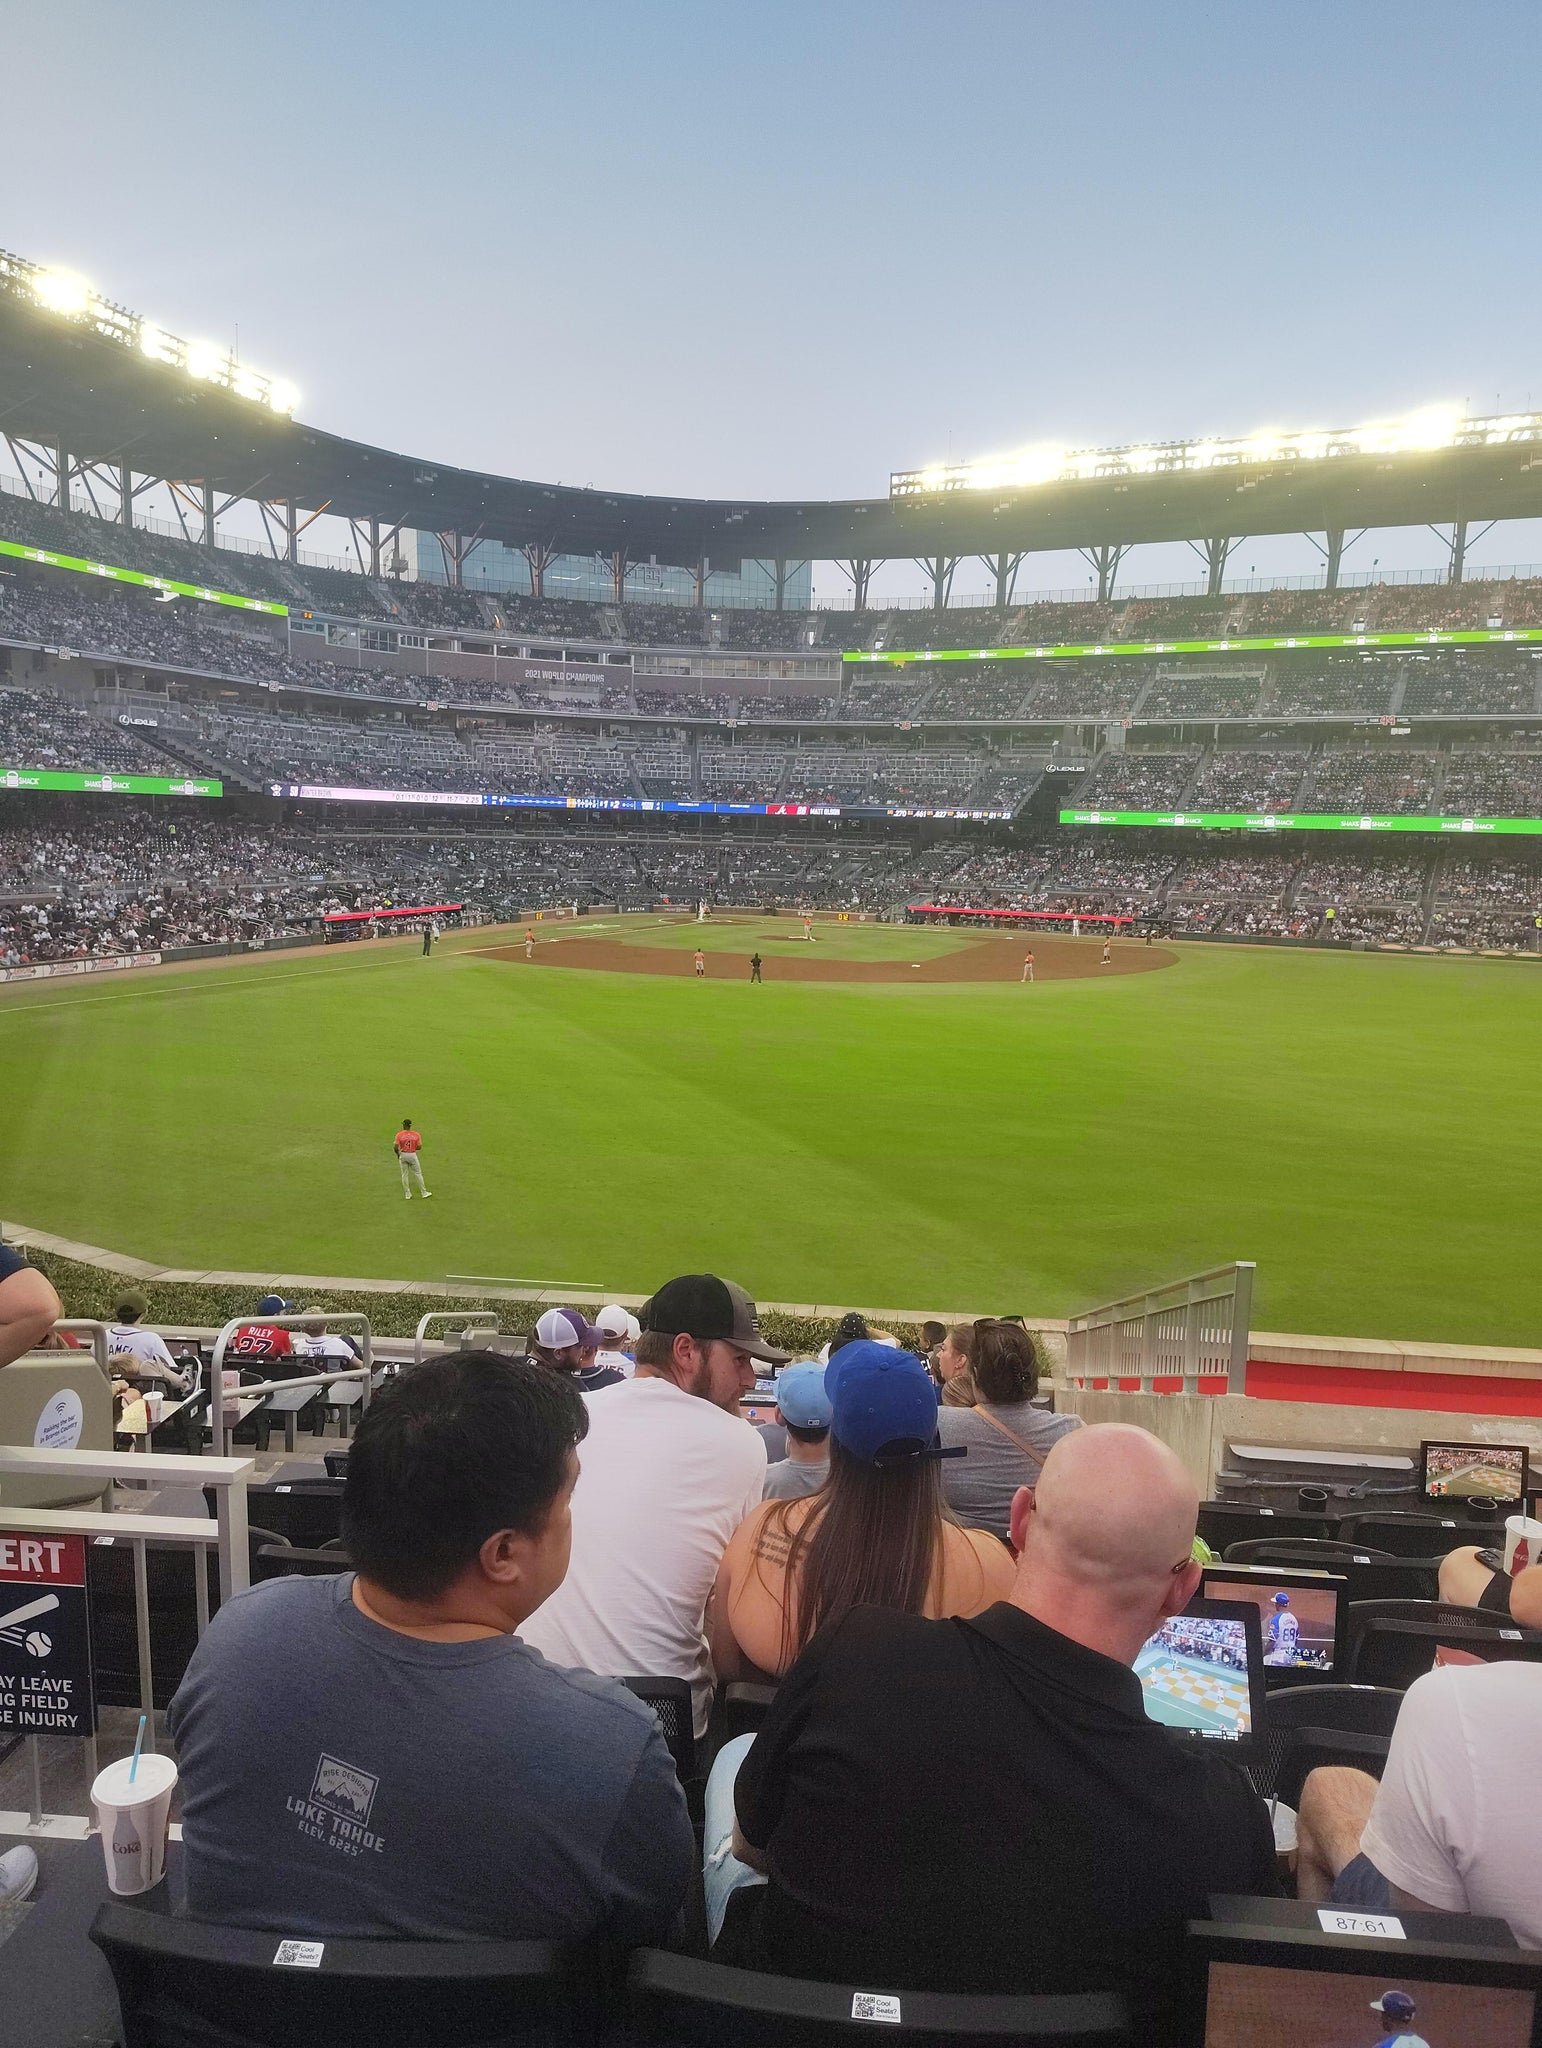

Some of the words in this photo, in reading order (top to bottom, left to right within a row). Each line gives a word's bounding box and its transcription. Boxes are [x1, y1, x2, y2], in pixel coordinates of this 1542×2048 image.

[525, 669, 541, 678] 2021
[541, 670, 564, 680] WORLD
[566, 672, 605, 682] CHAMPIONS
[130, 717, 158, 726] LEXUS
[248, 1326, 274, 1338] RILEY
[240, 1336, 274, 1353] 27
[0, 1539, 65, 1574] ERT
[21, 1677, 73, 1693] LEAVE
[22, 1694, 69, 1710] FIELD
[19, 1711, 79, 1728] INJURY
[322, 1768, 340, 1778] RISE
[341, 1770, 370, 1797] DESIGNS
[285, 1796, 327, 1826] LAKE
[332, 1816, 386, 1853] TAHOE
[298, 1820, 326, 1842] ELEV.
[1336, 1916, 1387, 1934] 87:61
[876, 1999, 891, 2007] Cool
[876, 2007, 897, 2015] Seats?
